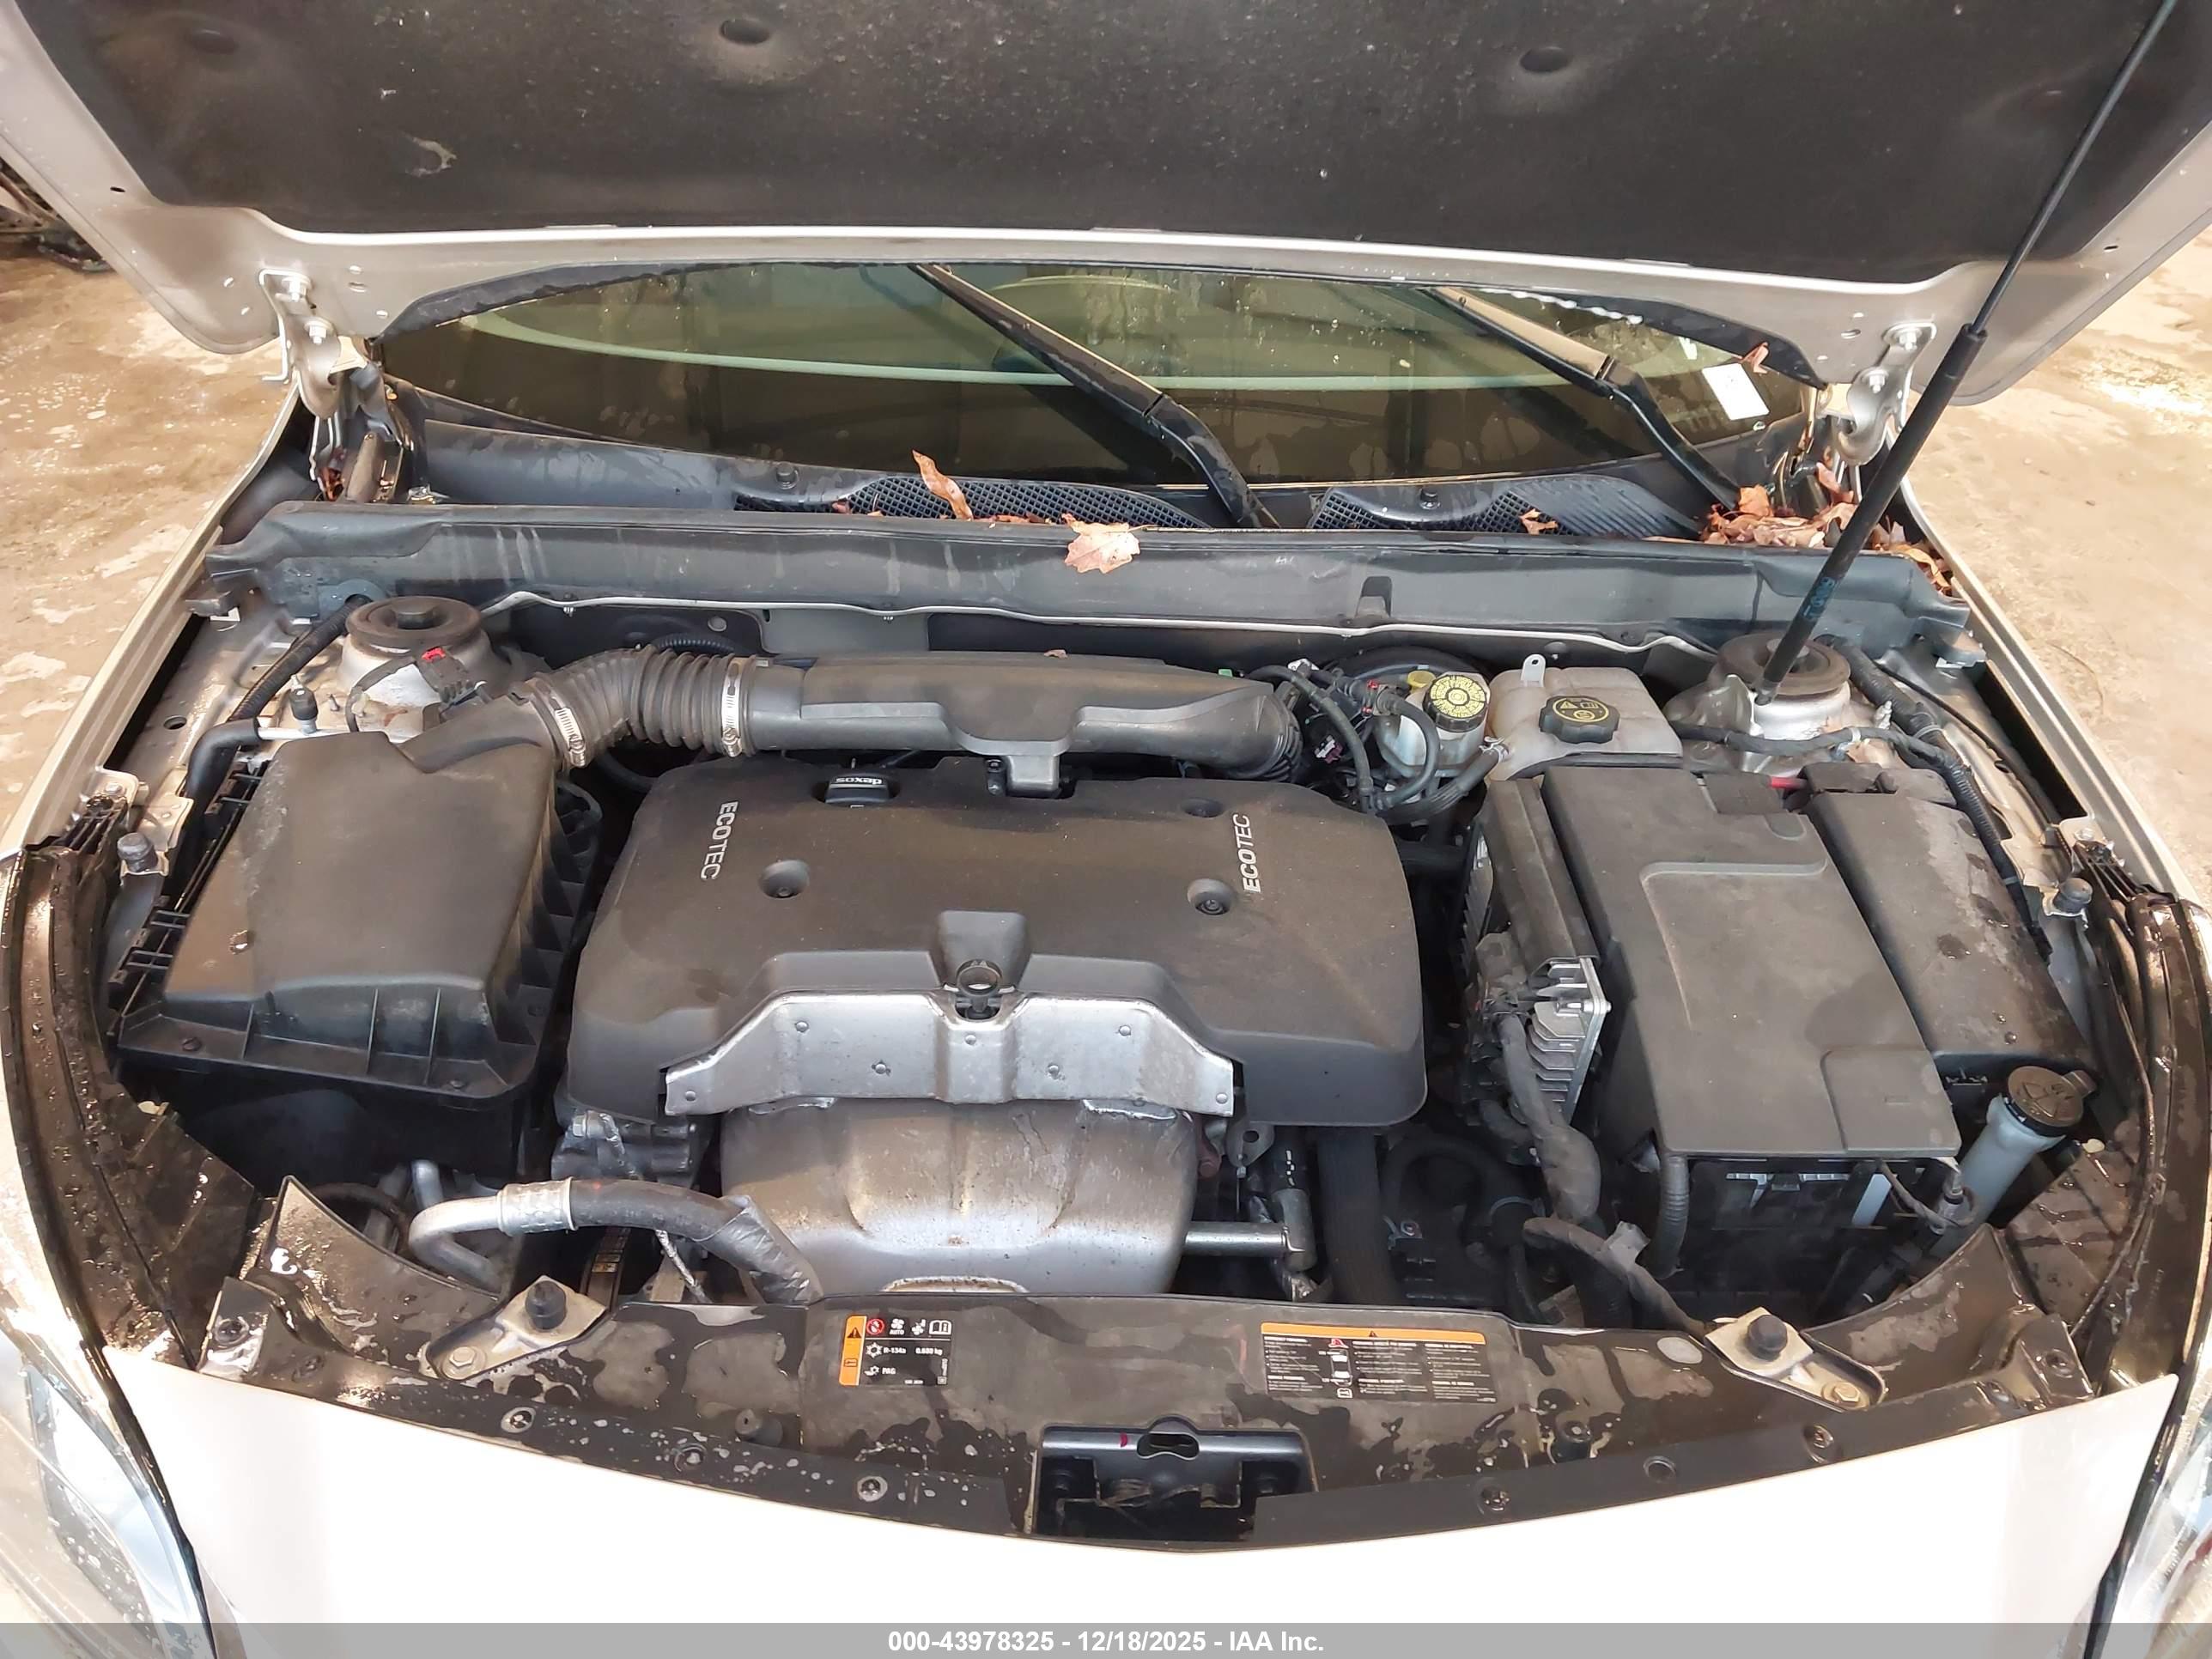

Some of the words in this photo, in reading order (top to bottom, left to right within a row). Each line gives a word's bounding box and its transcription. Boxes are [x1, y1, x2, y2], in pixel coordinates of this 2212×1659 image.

[836, 776, 883, 786] dexos
[700, 801, 738, 881] ECOTEC
[1232, 813, 1261, 893] ECOTEC
[882, 1367, 896, 1376] PAG
